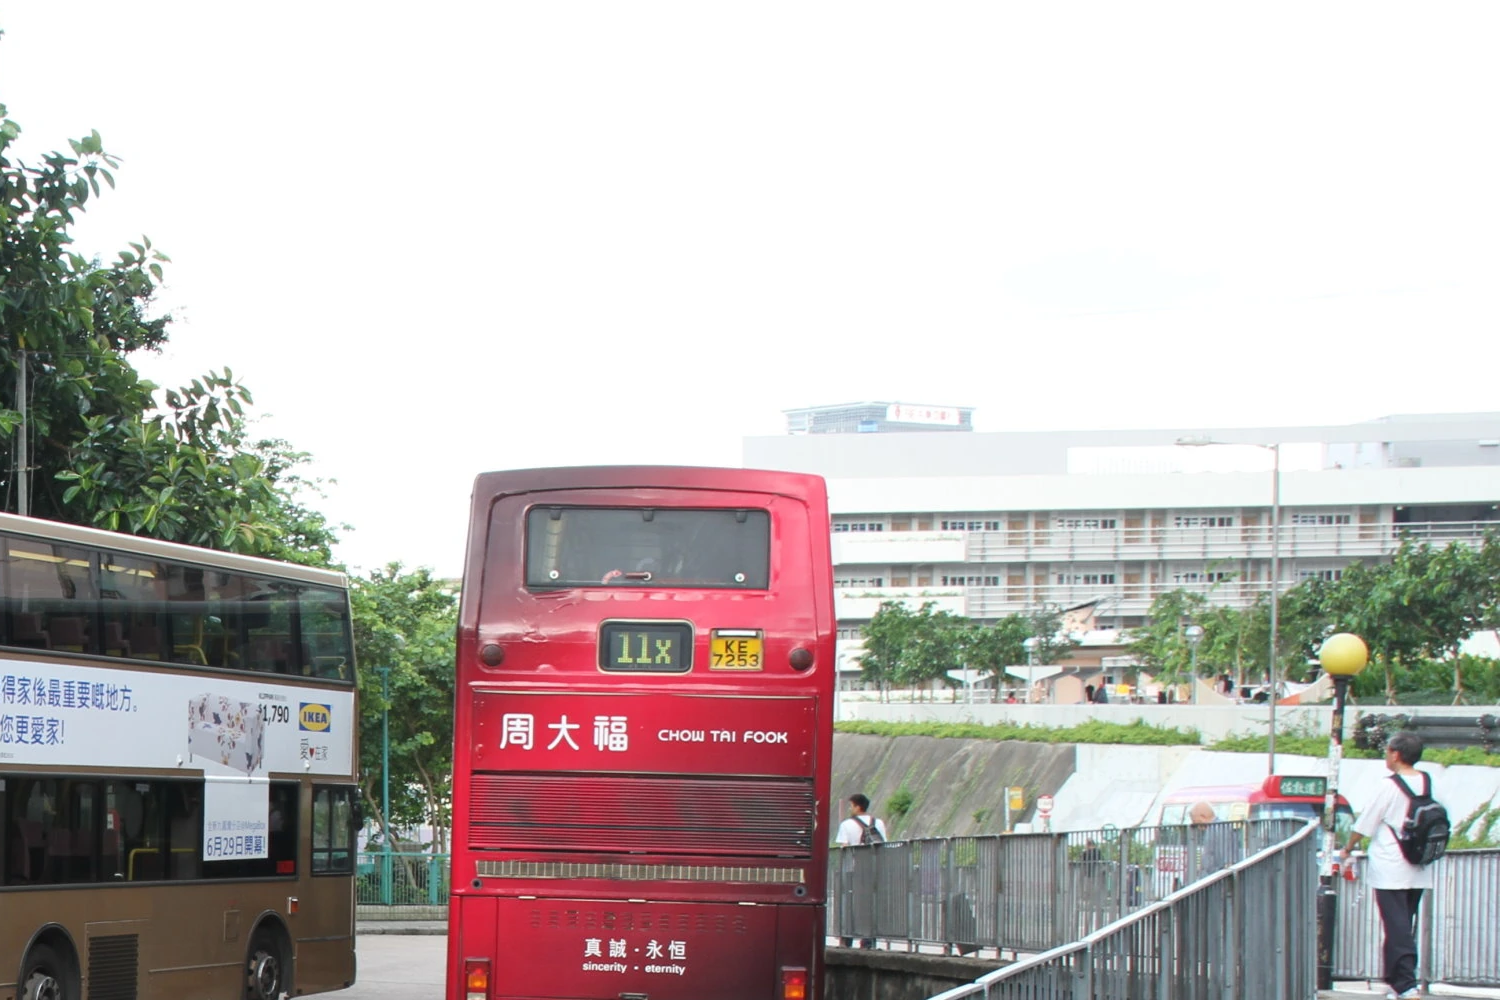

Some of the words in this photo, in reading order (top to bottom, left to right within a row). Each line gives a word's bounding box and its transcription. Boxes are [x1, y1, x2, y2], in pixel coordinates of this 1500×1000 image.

[724, 640, 748, 654] KE
[713, 654, 759, 667] 7253
[303, 711, 328, 724] IKEA
[500, 713, 628, 751] 周大福
[658, 729, 705, 743] CHOW
[710, 730, 736, 743] TAI
[743, 730, 789, 744] FOOK
[206, 835, 266, 857] 6月29日開幕!
[582, 960, 627, 974] sincerity
[644, 963, 686, 976] eternity
